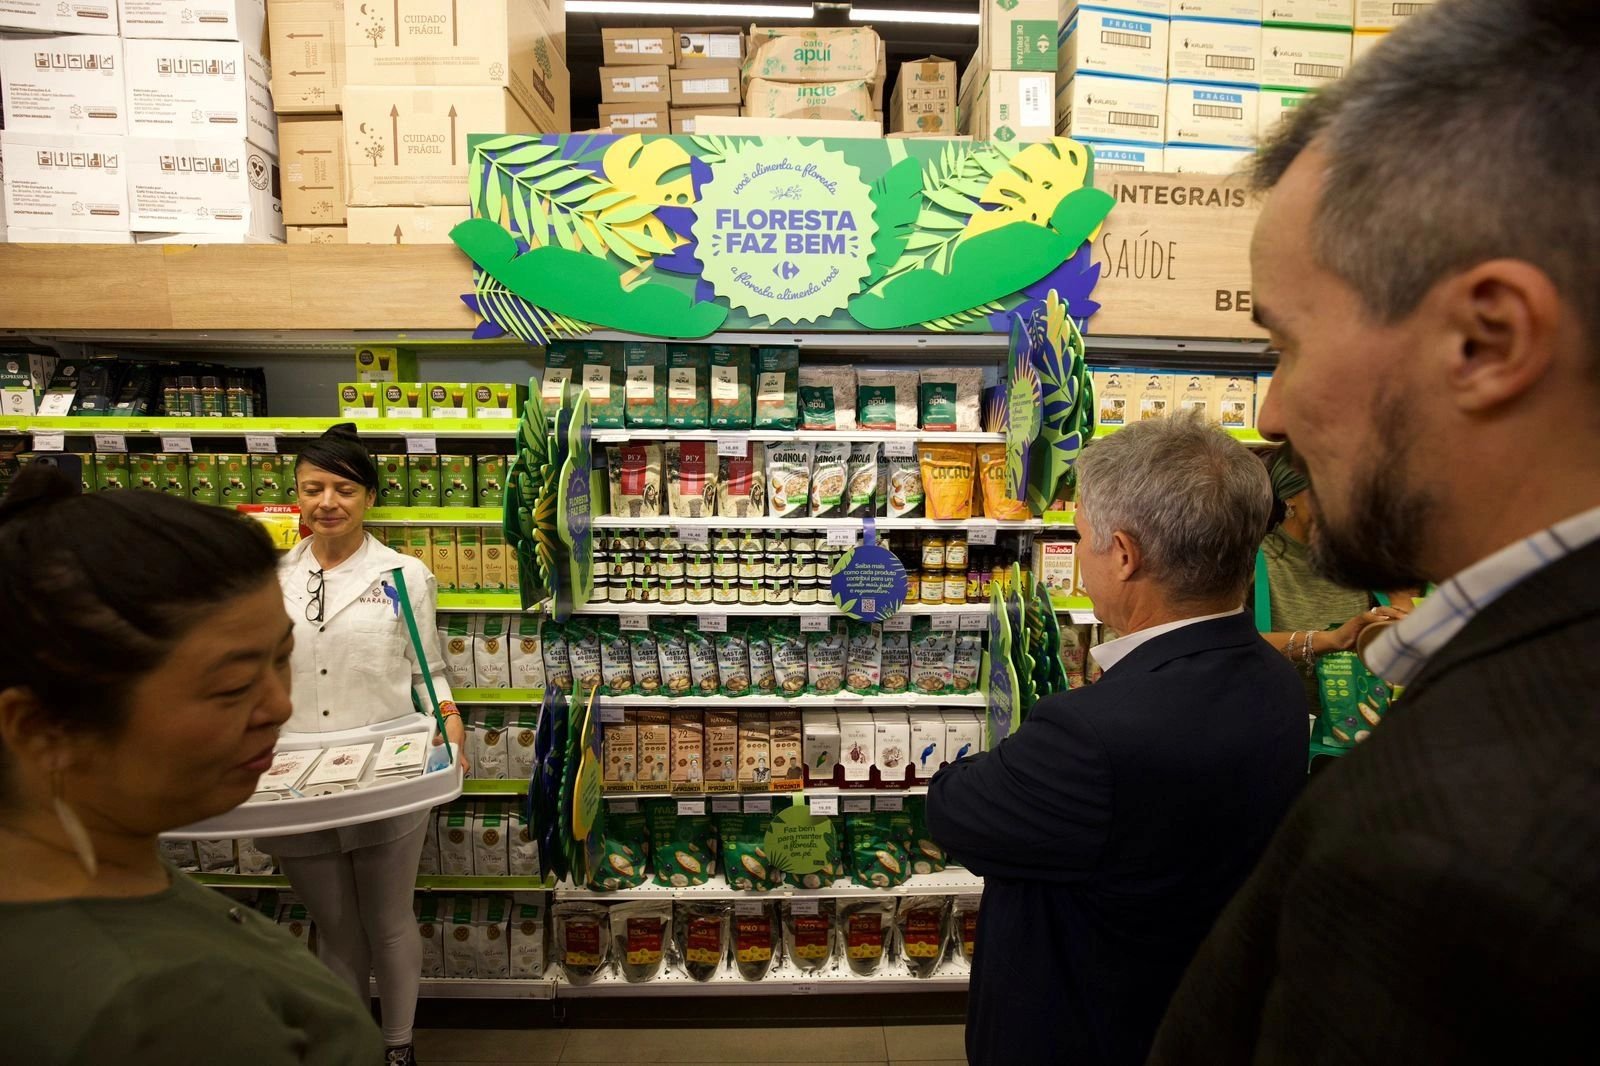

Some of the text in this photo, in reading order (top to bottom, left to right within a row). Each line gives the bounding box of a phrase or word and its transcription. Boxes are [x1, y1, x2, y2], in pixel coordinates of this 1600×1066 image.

[404, 15, 447, 24] CUIDADO
[409, 24, 442, 35] FRÁGIL
[1108, 20, 1145, 31] FRÁGIL
[793, 44, 832, 65] apuí
[1016, 36, 1024, 65] FRUTAS
[1200, 92, 1235, 102] FRÁGIL
[403, 134, 446, 143] CUIDADO
[407, 143, 442, 154] FRÁGIL
[1100, 151, 1137, 160] FRÁGIL
[733, 157, 836, 195] você alimenta a floresta
[1113, 184, 1246, 208] INTEGRAIS
[716, 209, 857, 231] FLORESTA
[726, 233, 846, 255] FAZ BEM
[1100, 230, 1177, 280] SAÚDE
[730, 265, 840, 300] a floresta alimenta você
[1215, 289, 1251, 312] BE
[773, 453, 807, 463] GRANOLA
[931, 466, 971, 480] CACAU
[282, 529, 299, 545] 17
[610, 732, 620, 740] 63
[644, 732, 654, 740] 63
[678, 730, 688, 738] 72
[712, 732, 723, 740] 72
[784, 826, 797, 834] Faz
[778, 832, 822, 844] para manter
